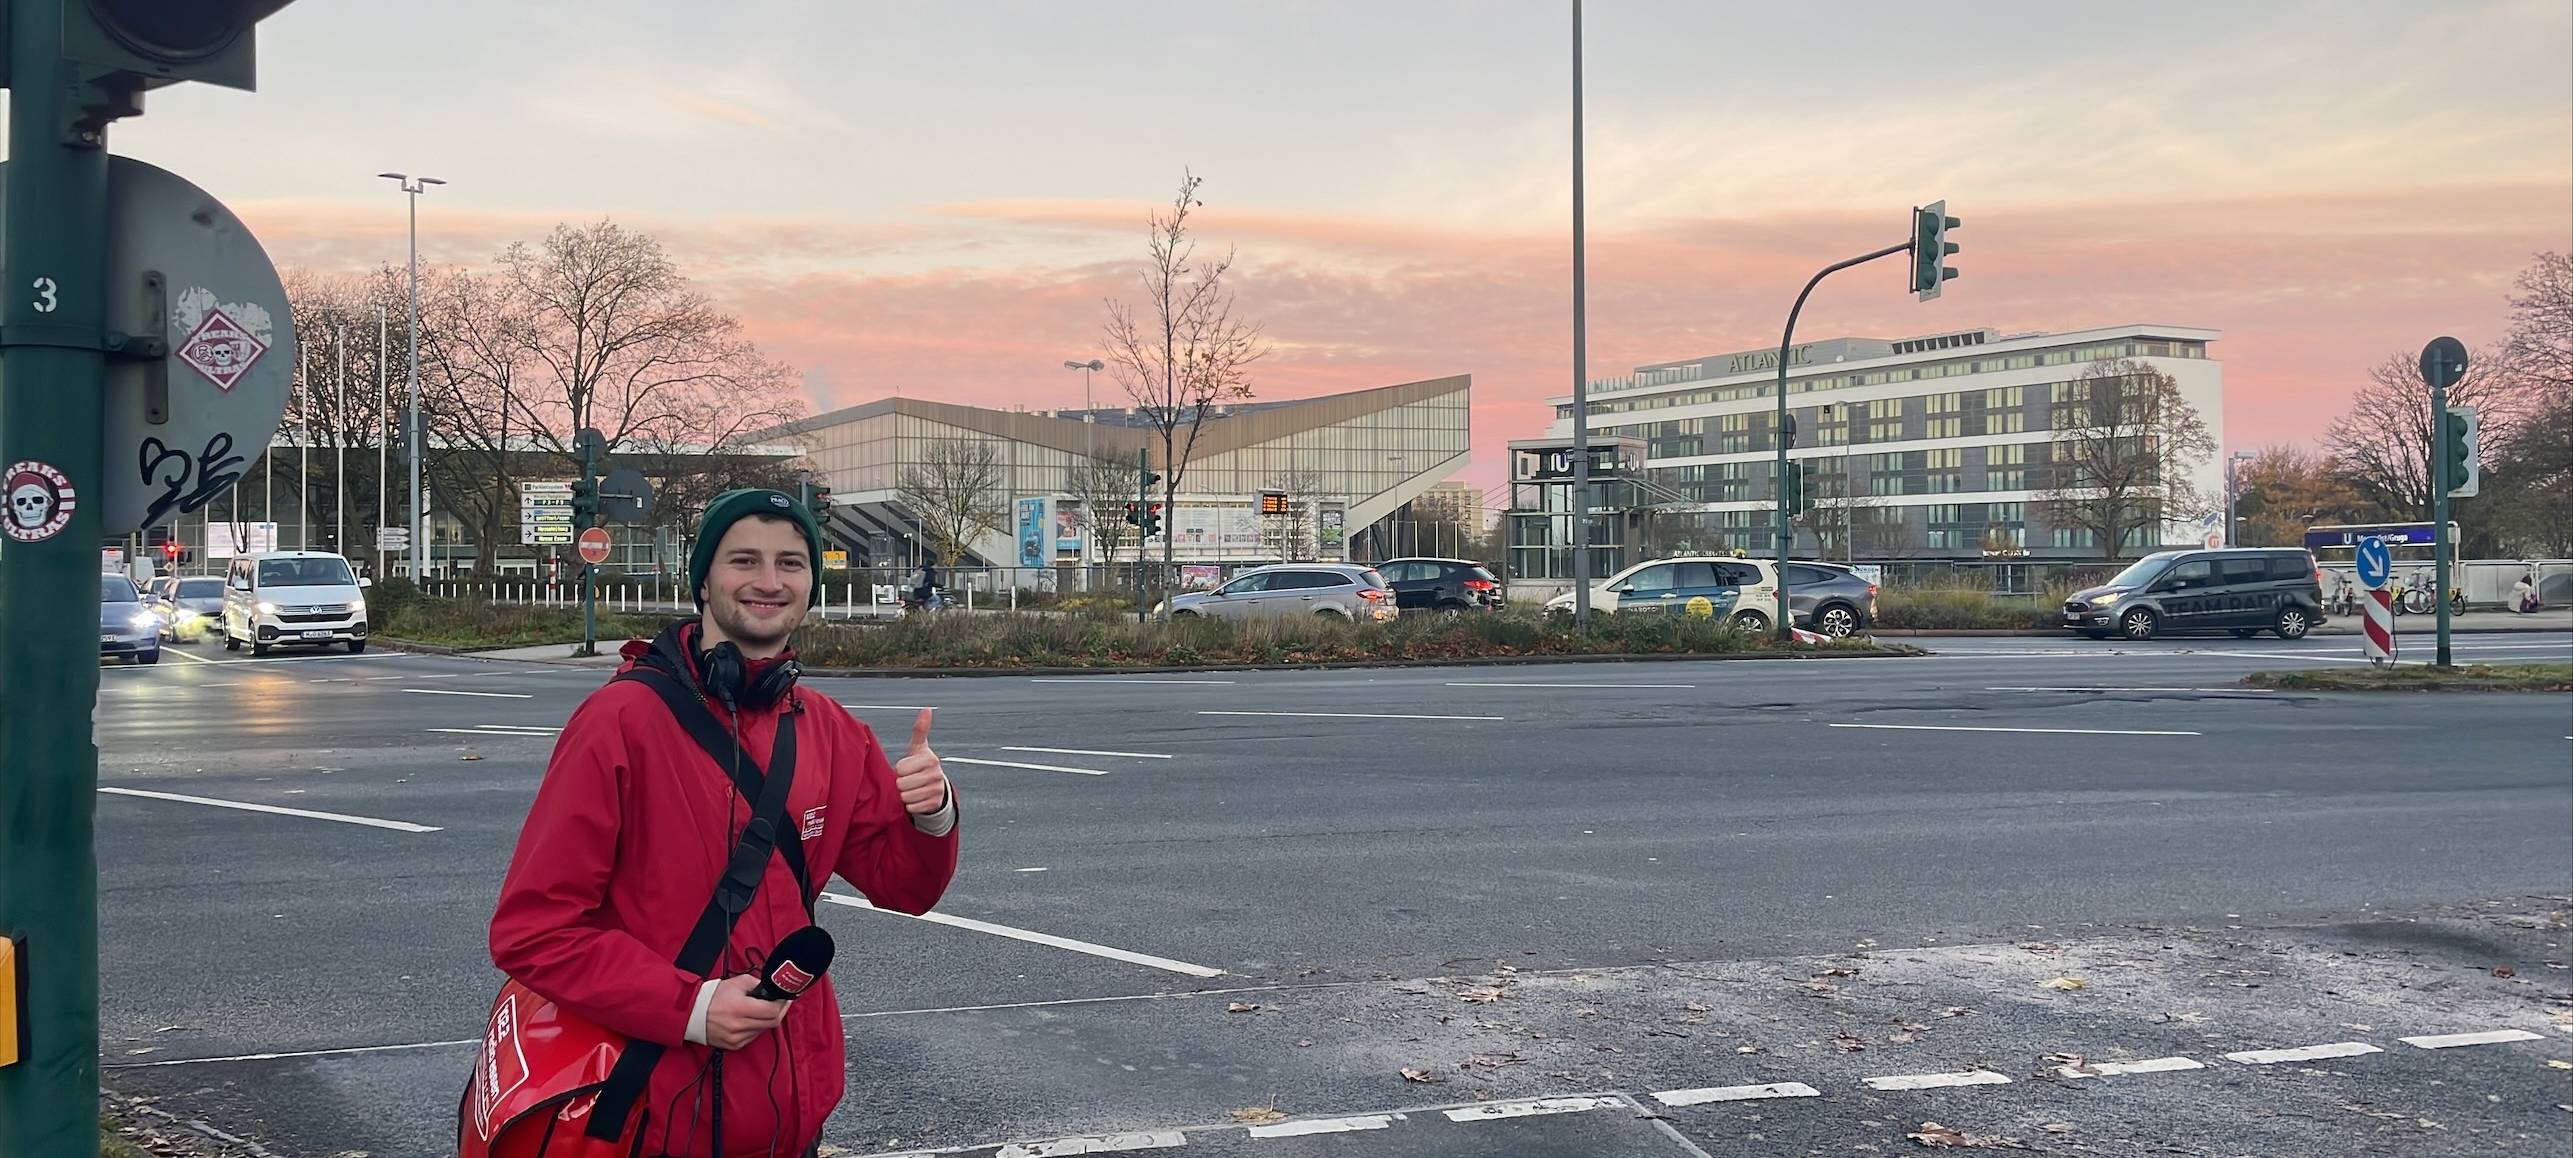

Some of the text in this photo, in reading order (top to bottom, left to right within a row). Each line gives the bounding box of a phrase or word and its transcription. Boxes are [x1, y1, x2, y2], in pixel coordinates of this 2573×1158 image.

[33, 277, 57, 313] 3
[2343, 532, 2352, 545] U
[2165, 591, 2297, 614] TEAM RADIO
